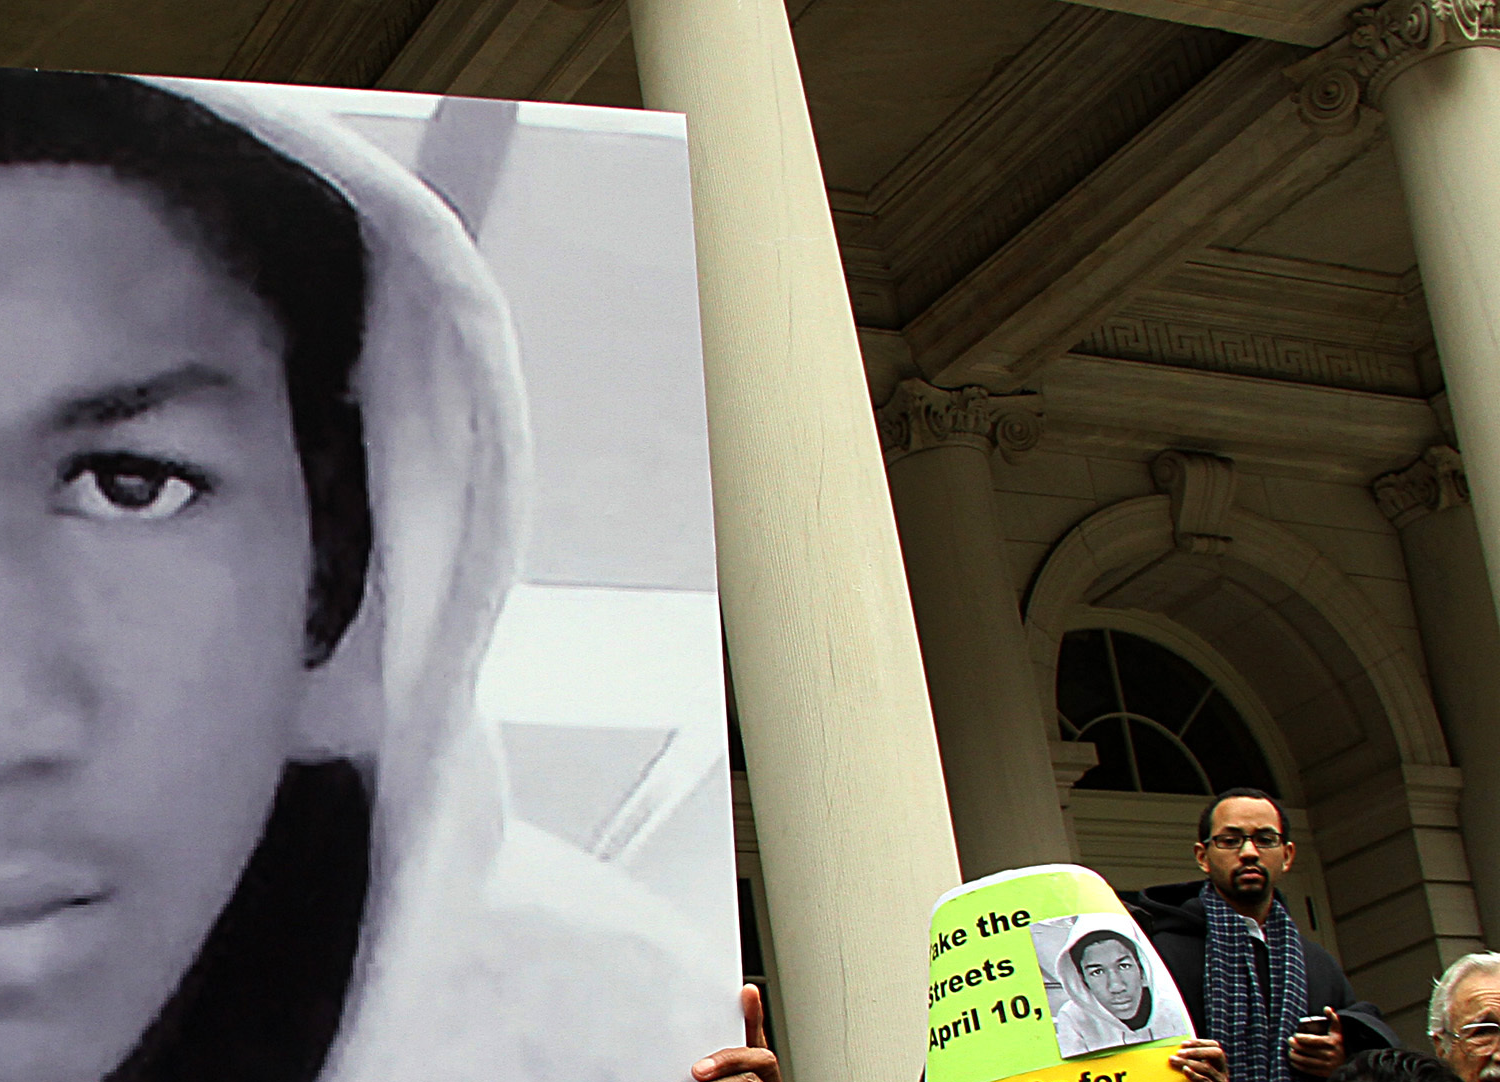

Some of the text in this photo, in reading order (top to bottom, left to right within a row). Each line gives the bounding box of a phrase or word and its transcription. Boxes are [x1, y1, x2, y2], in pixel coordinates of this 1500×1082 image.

[929, 910, 1031, 968] ake the
[929, 995, 1043, 1052] April 10,
